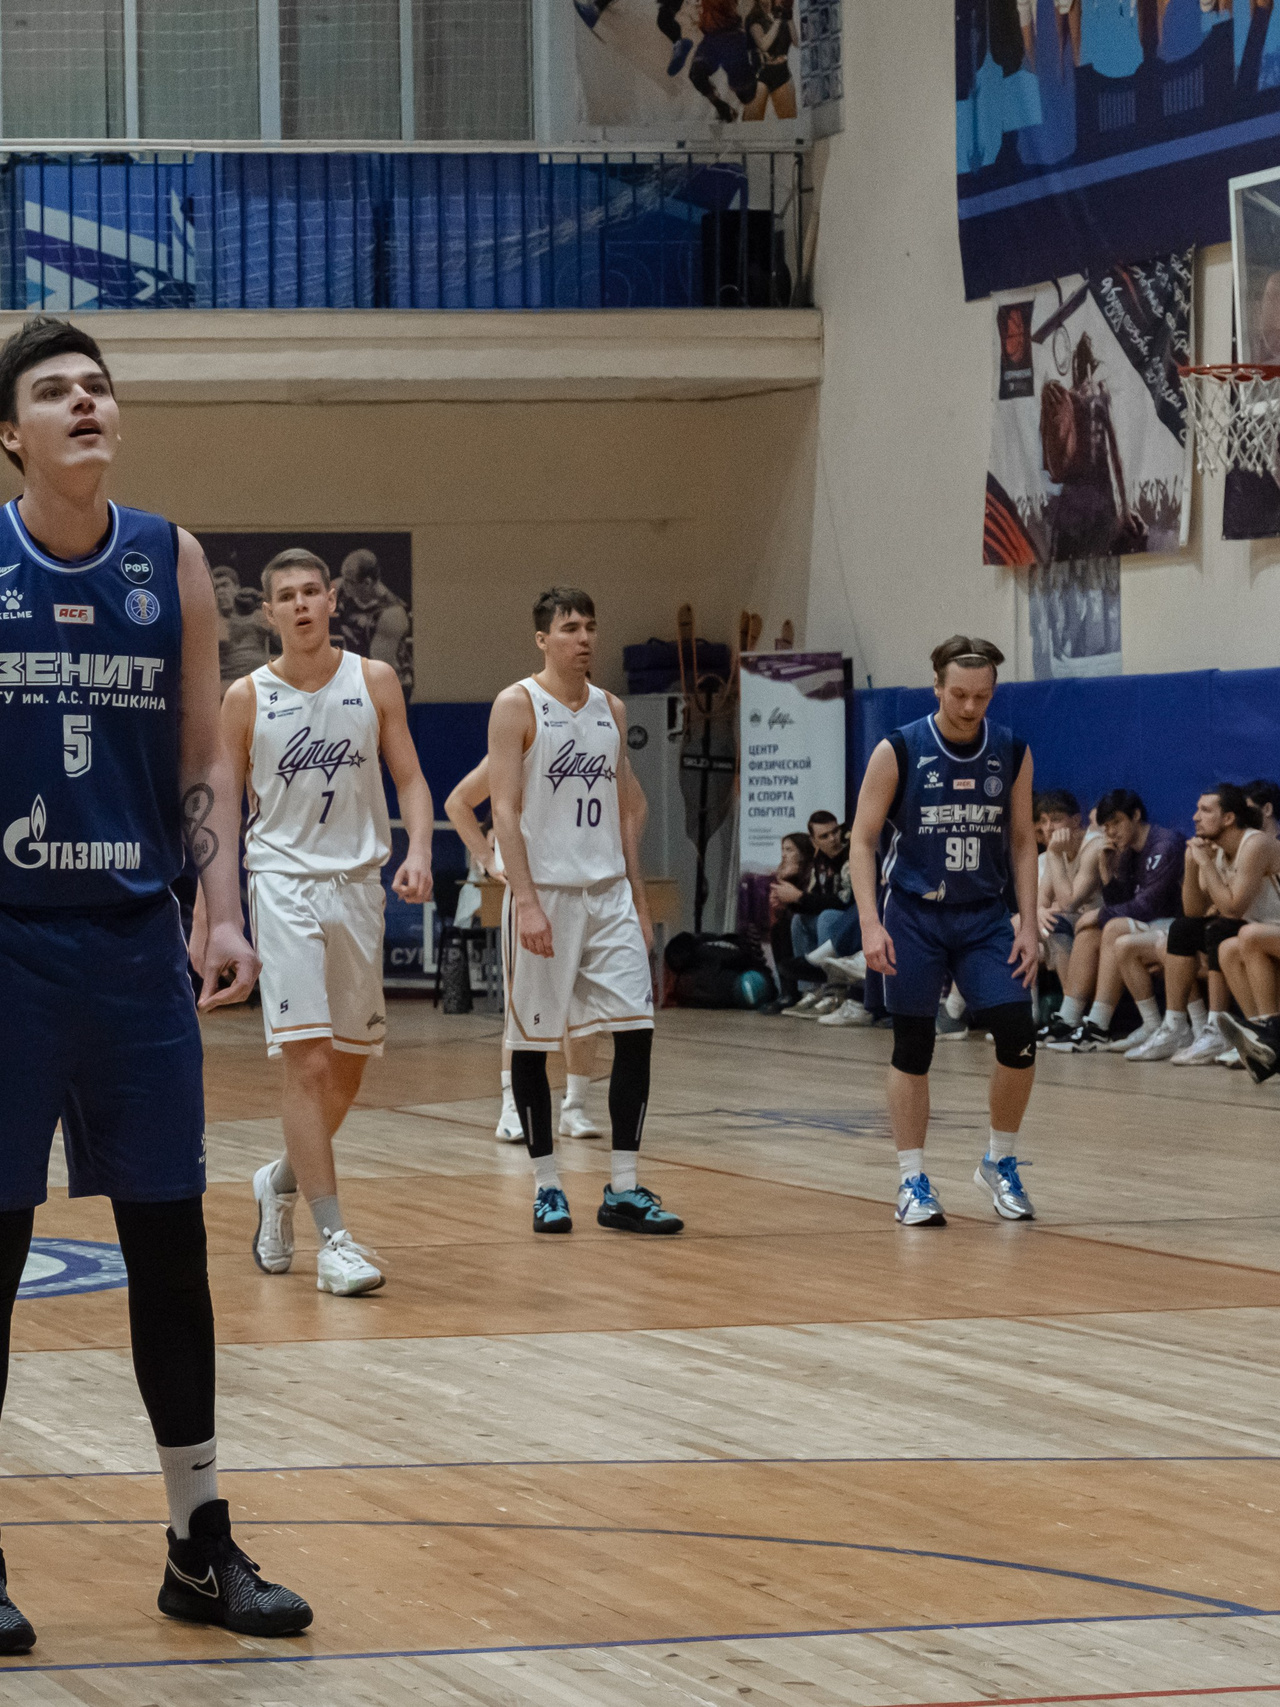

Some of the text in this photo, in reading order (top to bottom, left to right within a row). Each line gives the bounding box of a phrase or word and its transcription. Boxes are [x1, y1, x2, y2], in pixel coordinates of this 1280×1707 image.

[124, 562, 150, 574] РФБ
[57, 693, 83, 706] А.С.
[89, 692, 167, 711] ПУШКИНА
[62, 714, 92, 778] 5
[748, 744, 779, 755] ЦЕНТР
[748, 756, 812, 771] ФИЗИЧЕСКОЙ
[748, 775, 799, 786] КУЛЬТУРЫ
[748, 790, 794, 802] И СПОРТА
[318, 790, 335, 824] 7
[575, 797, 602, 828] 10
[920, 804, 1003, 825] ЗЕНИТ
[918, 826, 934, 835] ЛГУ
[945, 837, 981, 871] 99
